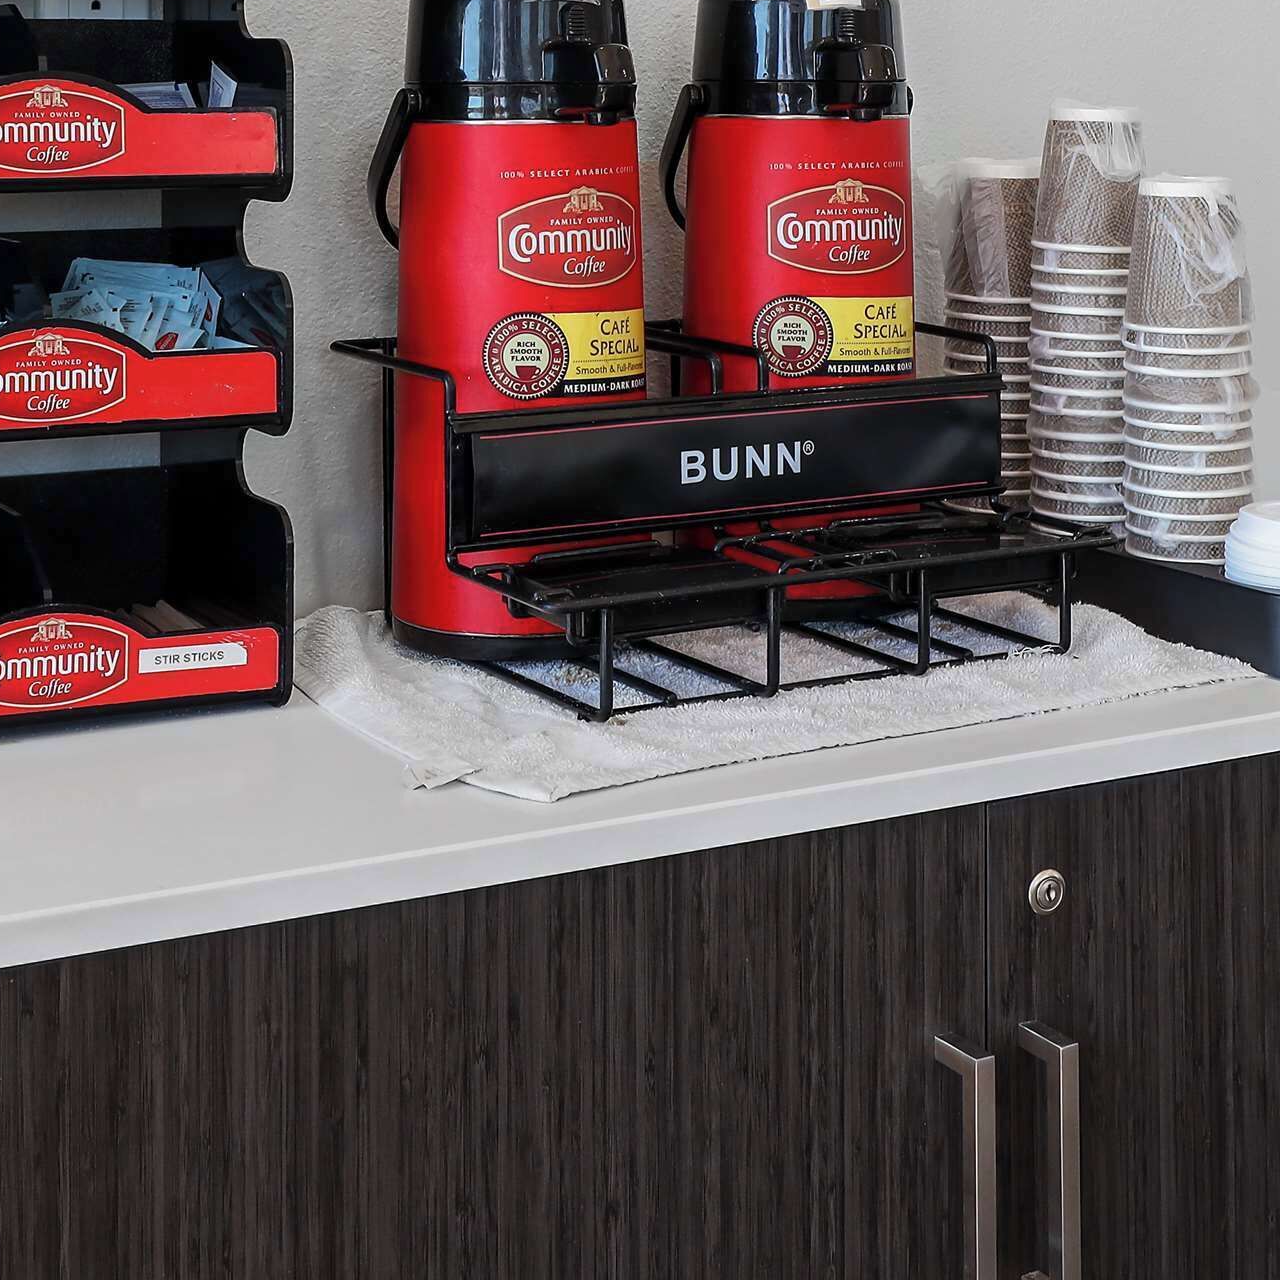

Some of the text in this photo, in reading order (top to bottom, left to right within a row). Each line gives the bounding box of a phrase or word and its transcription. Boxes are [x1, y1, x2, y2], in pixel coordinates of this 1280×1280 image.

[26, 146, 69, 164] Coffee
[530, 169, 570, 178] SELECT
[576, 168, 614, 176] ARABICA
[798, 162, 836, 170] SELECT
[816, 208, 848, 216] FAMILY
[550, 216, 614, 226] FAMILY OWNED
[776, 212, 902, 250] Community
[508, 220, 630, 262] Community
[828, 244, 870, 264] Coffee
[564, 256, 606, 277] Coffee
[764, 304, 824, 331] 100% SELECT
[864, 304, 896, 320] CAFÉ
[494, 321, 560, 345] 100% SELECT
[600, 317, 630, 336] CAFÉ
[759, 338, 826, 370] ARABICA COFFEE
[840, 347, 880, 356] Smooth &
[16, 358, 82, 368] FAMILY OWNED
[576, 364, 616, 375] Smooth &
[828, 363, 895, 374] MEDIUM-DARK
[491, 356, 562, 393] ARABICA COFFEE
[564, 380, 630, 394] MEDIUM-DARK
[28, 394, 70, 413] Coffee
[18, 642, 84, 654] FAMILY OWNED
[154, 651, 224, 664] STIR STICKS
[28, 678, 72, 698] Coffee
